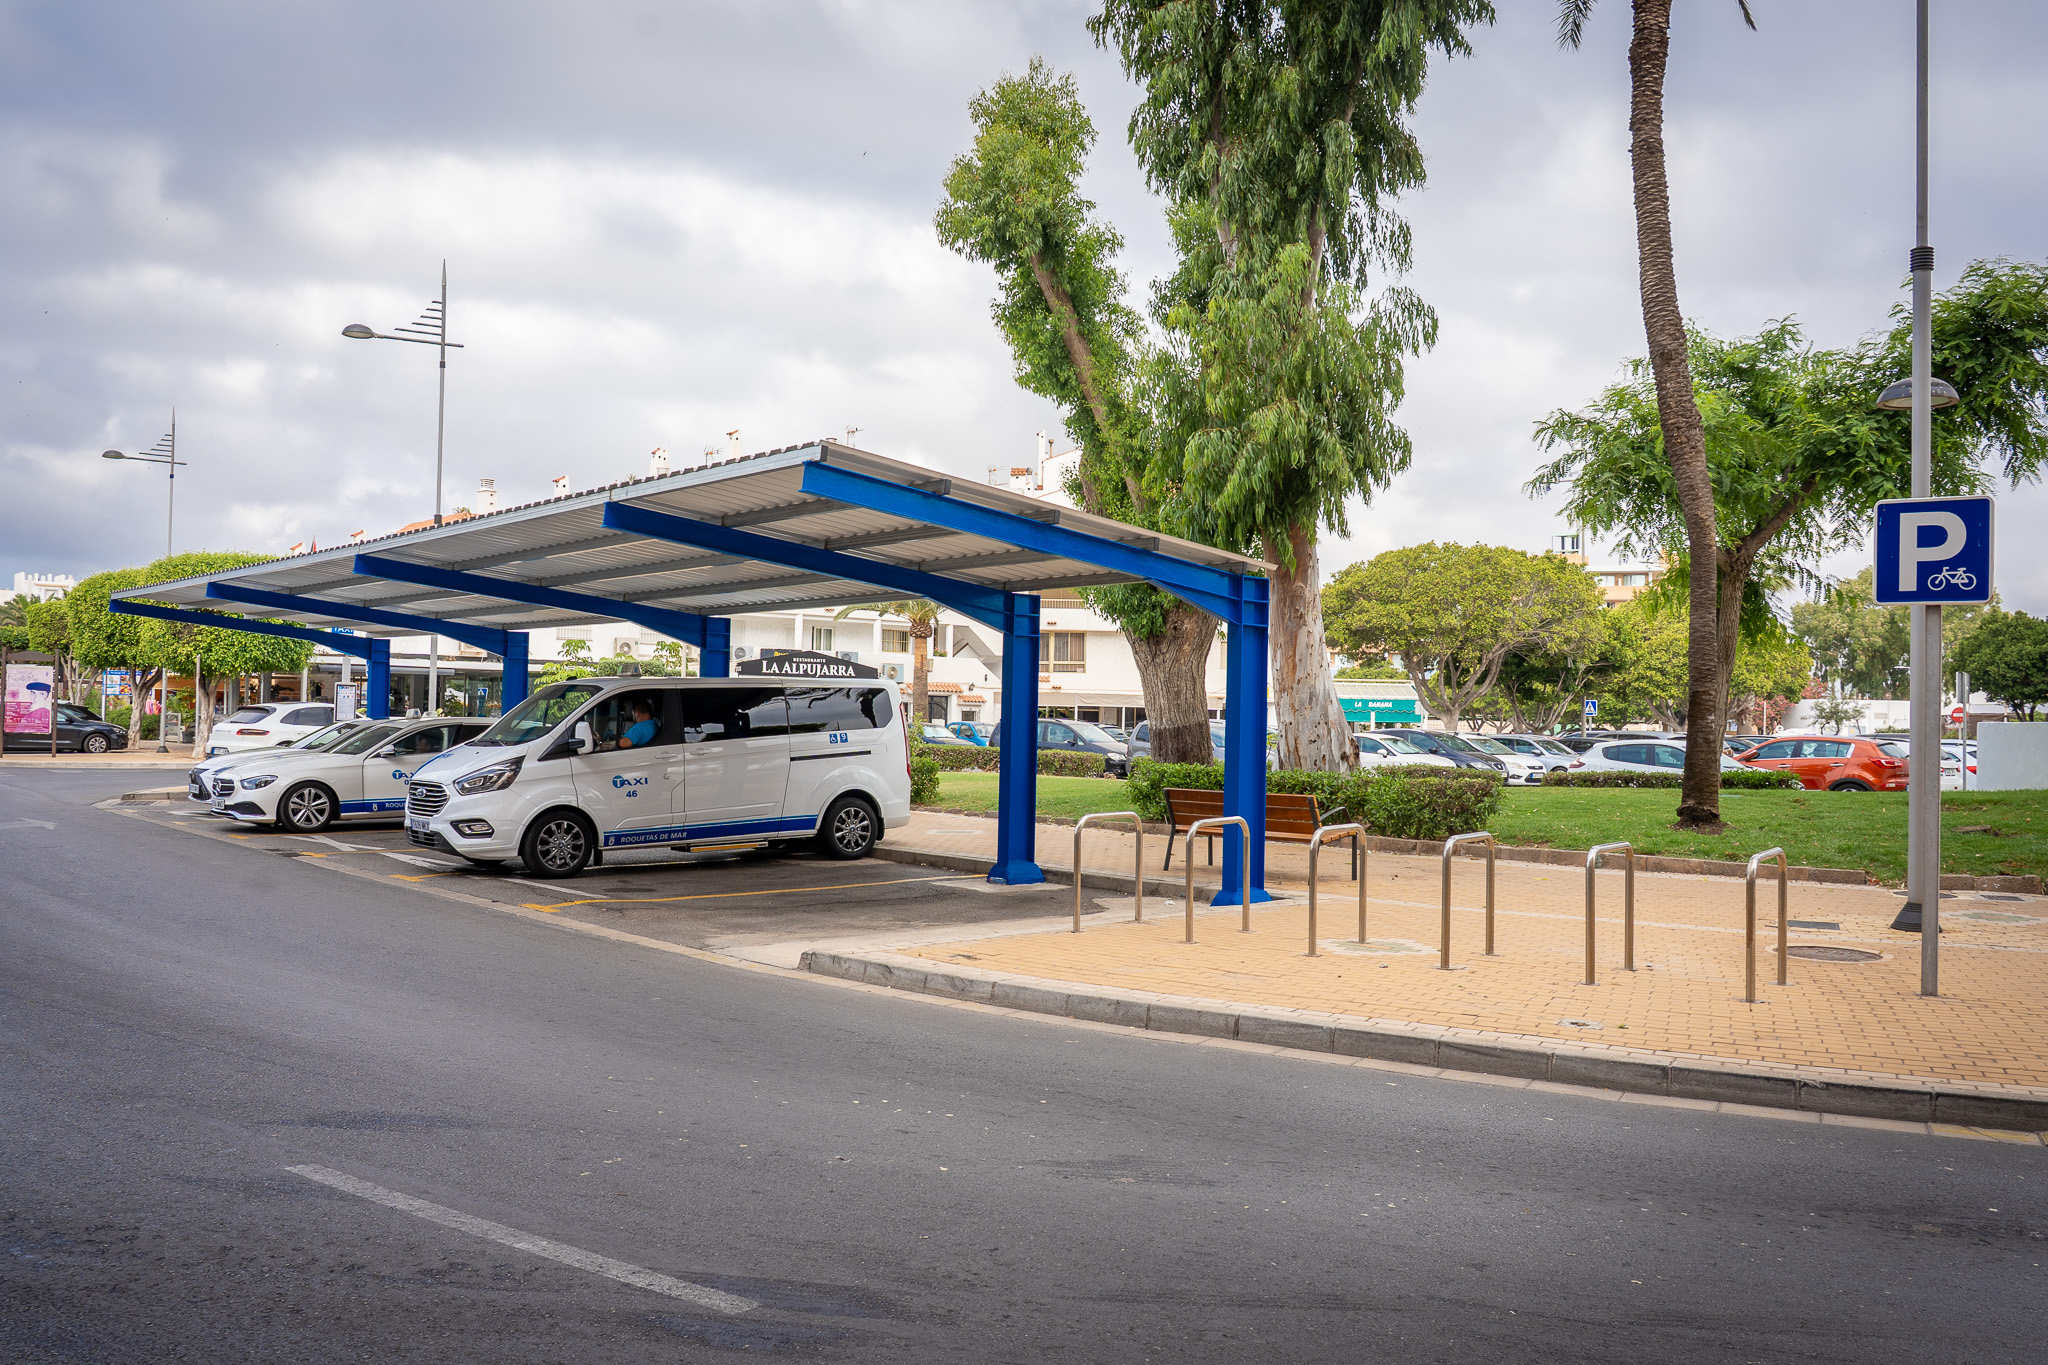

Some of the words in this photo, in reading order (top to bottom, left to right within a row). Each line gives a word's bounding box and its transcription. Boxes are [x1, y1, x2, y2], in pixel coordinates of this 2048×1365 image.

[1899, 511, 1967, 592] P
[762, 660, 780, 674] LA
[781, 661, 856, 678] ALPUJARRA
[612, 775, 648, 788] TAXI
[626, 790, 638, 798] 46
[620, 834, 658, 843] ROQUETAS
